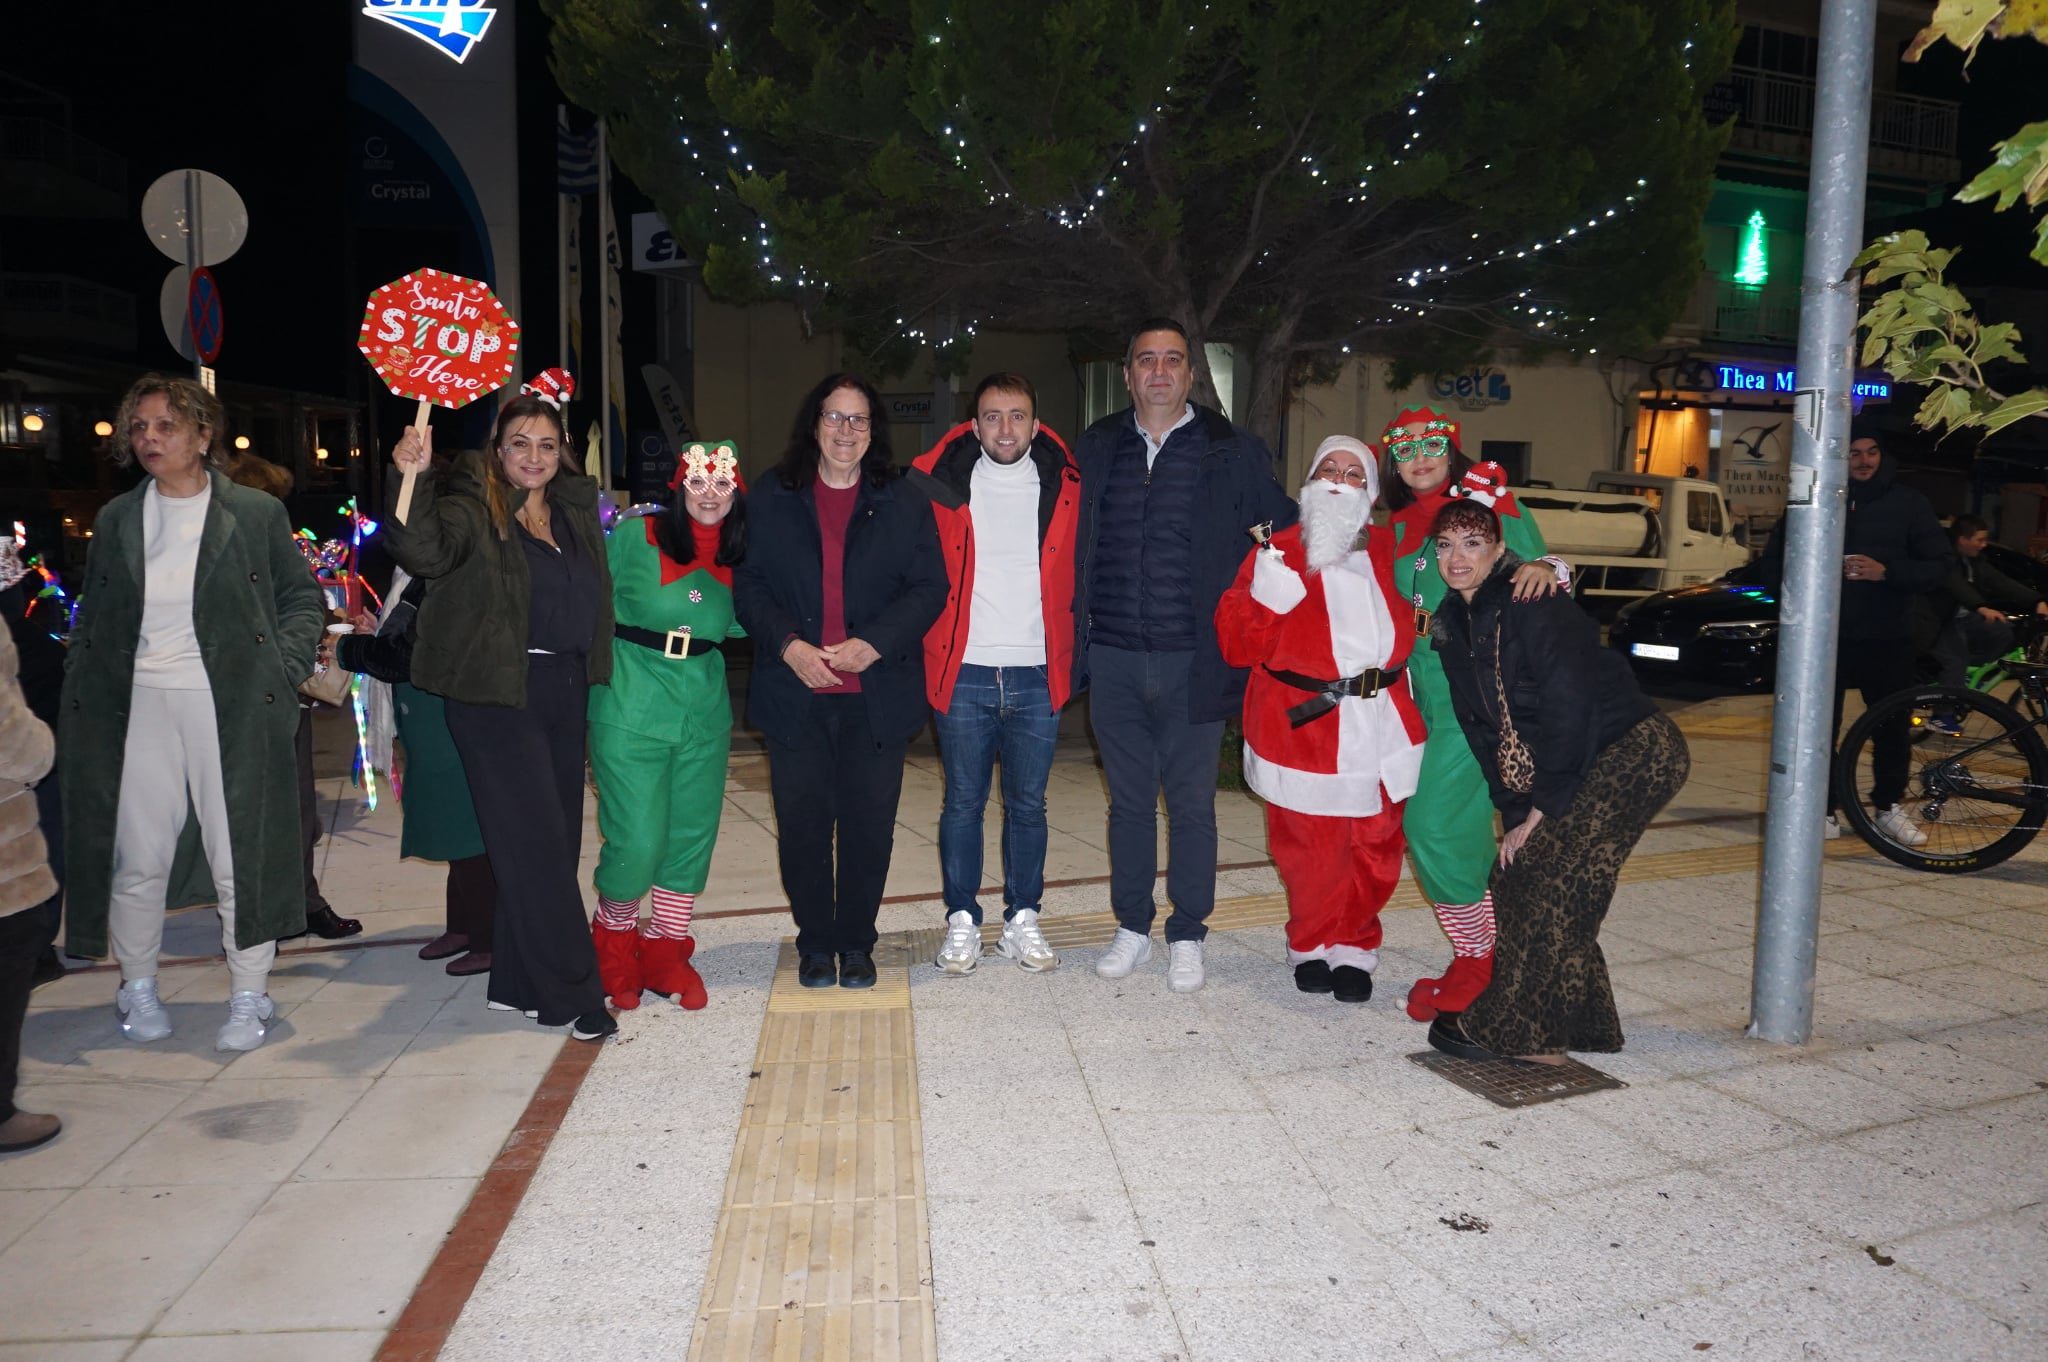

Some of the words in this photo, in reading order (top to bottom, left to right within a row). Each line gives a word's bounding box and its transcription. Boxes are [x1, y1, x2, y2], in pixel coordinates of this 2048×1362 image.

[371, 183, 431, 202] Crystal
[407, 281, 483, 320] Santa
[377, 308, 501, 364] STOP
[409, 354, 483, 390] Here
[1719, 367, 1765, 390] Thea
[1434, 367, 1484, 397] Get
[893, 399, 931, 414] Crystal
[1467, 397, 1490, 408] shop
[1465, 470, 1491, 486] HOHOHO
[1723, 468, 1752, 481] Thea
[1727, 483, 1782, 496] TAVERNA
